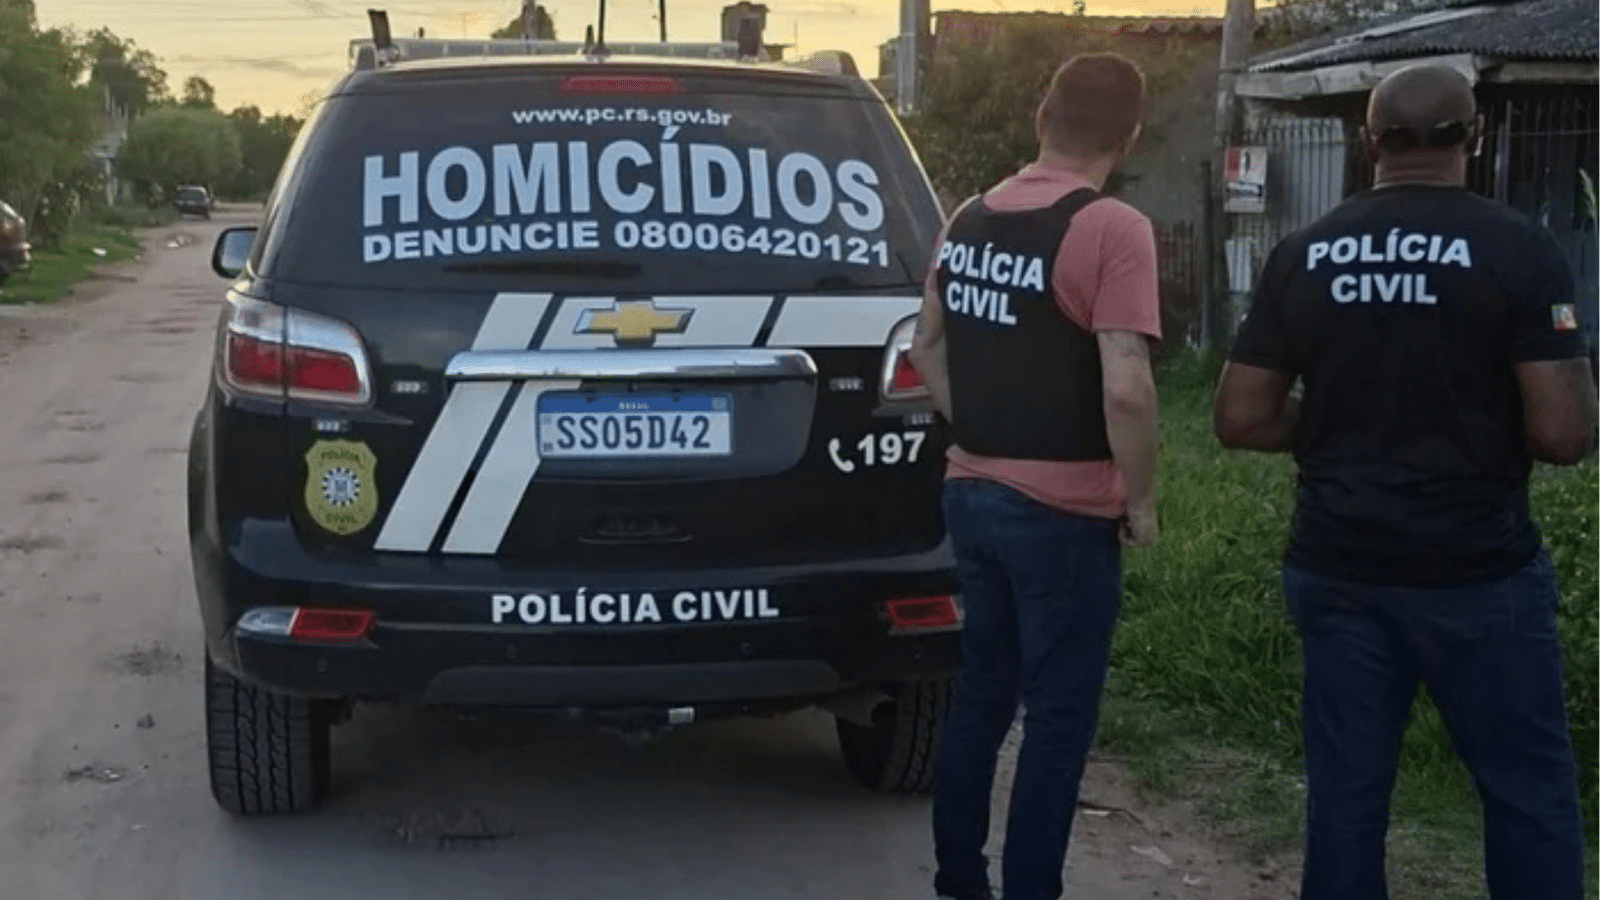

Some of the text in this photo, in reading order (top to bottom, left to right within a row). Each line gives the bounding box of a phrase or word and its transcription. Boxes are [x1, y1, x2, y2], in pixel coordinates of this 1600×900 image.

[512, 107, 733, 129] www.pc.rs.gov.br
[363, 126, 885, 232] HOMICÍDIOS
[363, 220, 889, 268] DENUNCIE 08006420121
[1306, 227, 1473, 270] POLÍCIA
[936, 240, 1044, 292] POLÍCIA
[946, 280, 1017, 325] CIVIL
[1330, 273, 1438, 304] CIVIL
[857, 431, 926, 465] 197
[492, 586, 780, 623] POLÍCIA CIVIL
